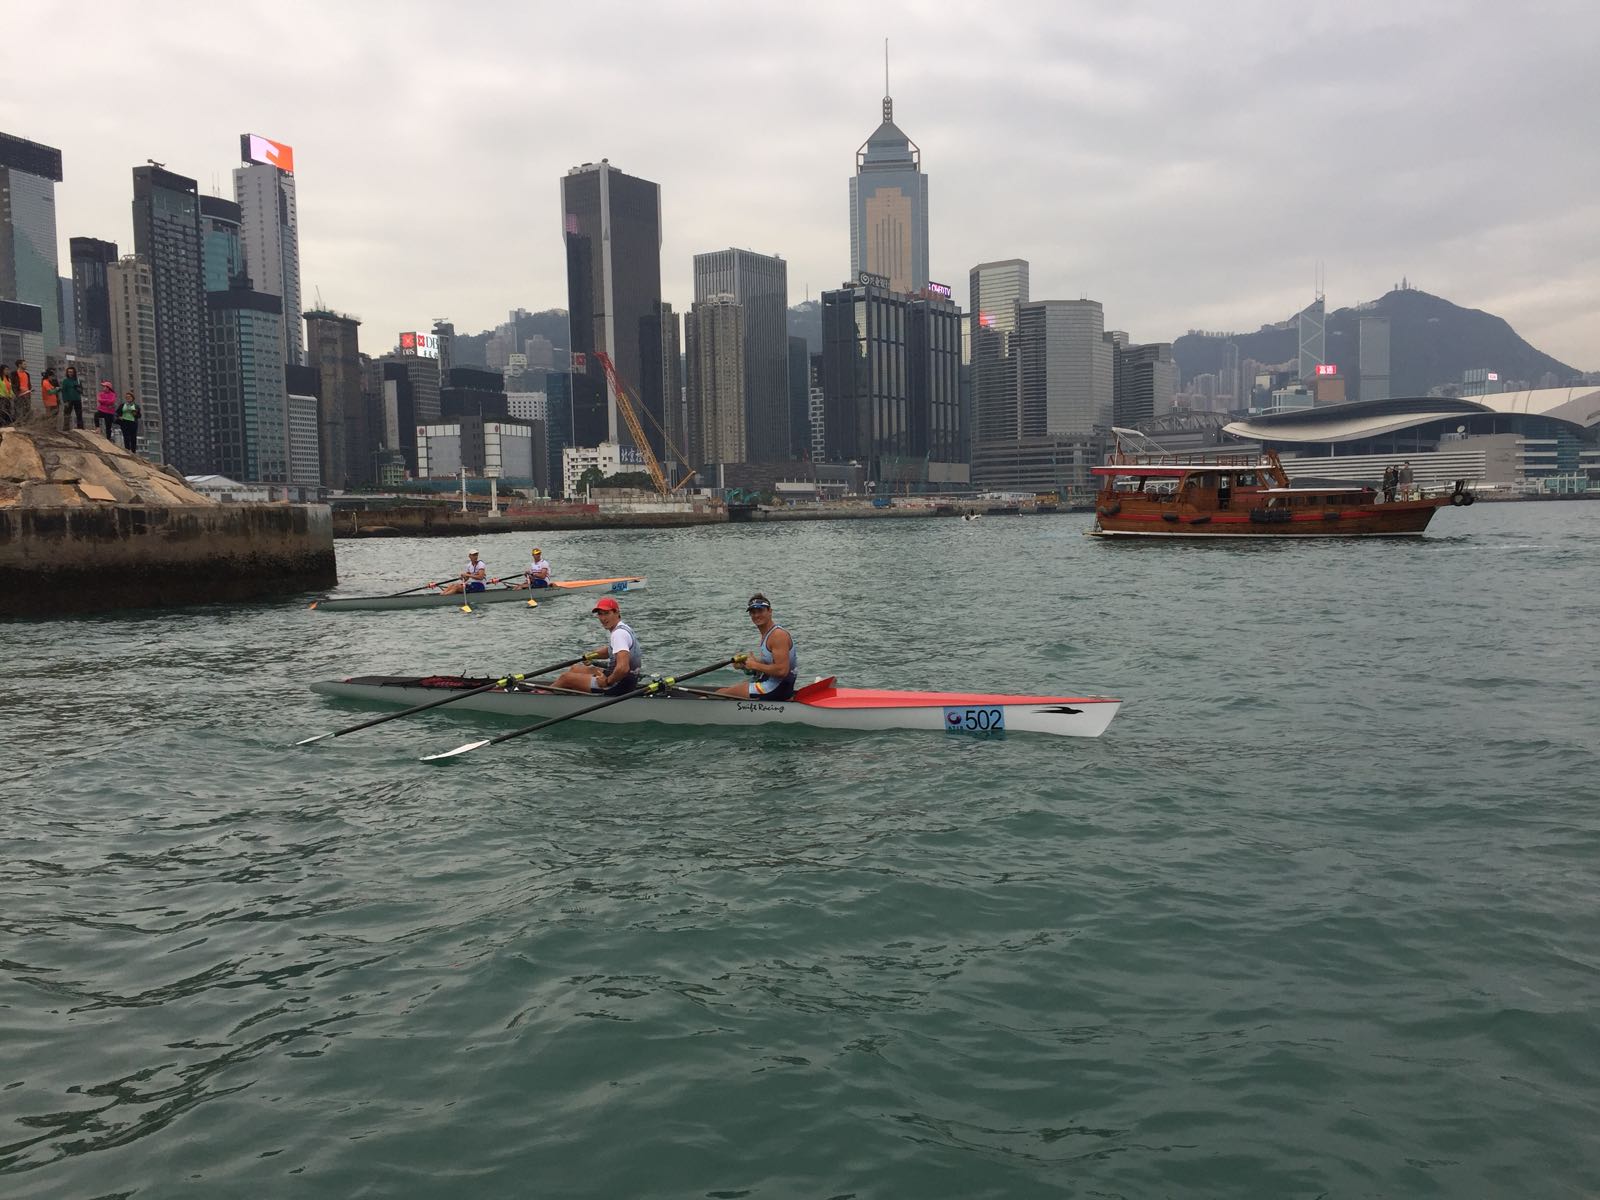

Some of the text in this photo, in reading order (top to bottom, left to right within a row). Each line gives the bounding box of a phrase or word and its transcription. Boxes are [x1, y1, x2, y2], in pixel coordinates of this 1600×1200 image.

[737, 702, 785, 713] Swift Racing
[966, 709, 1003, 730] 502
